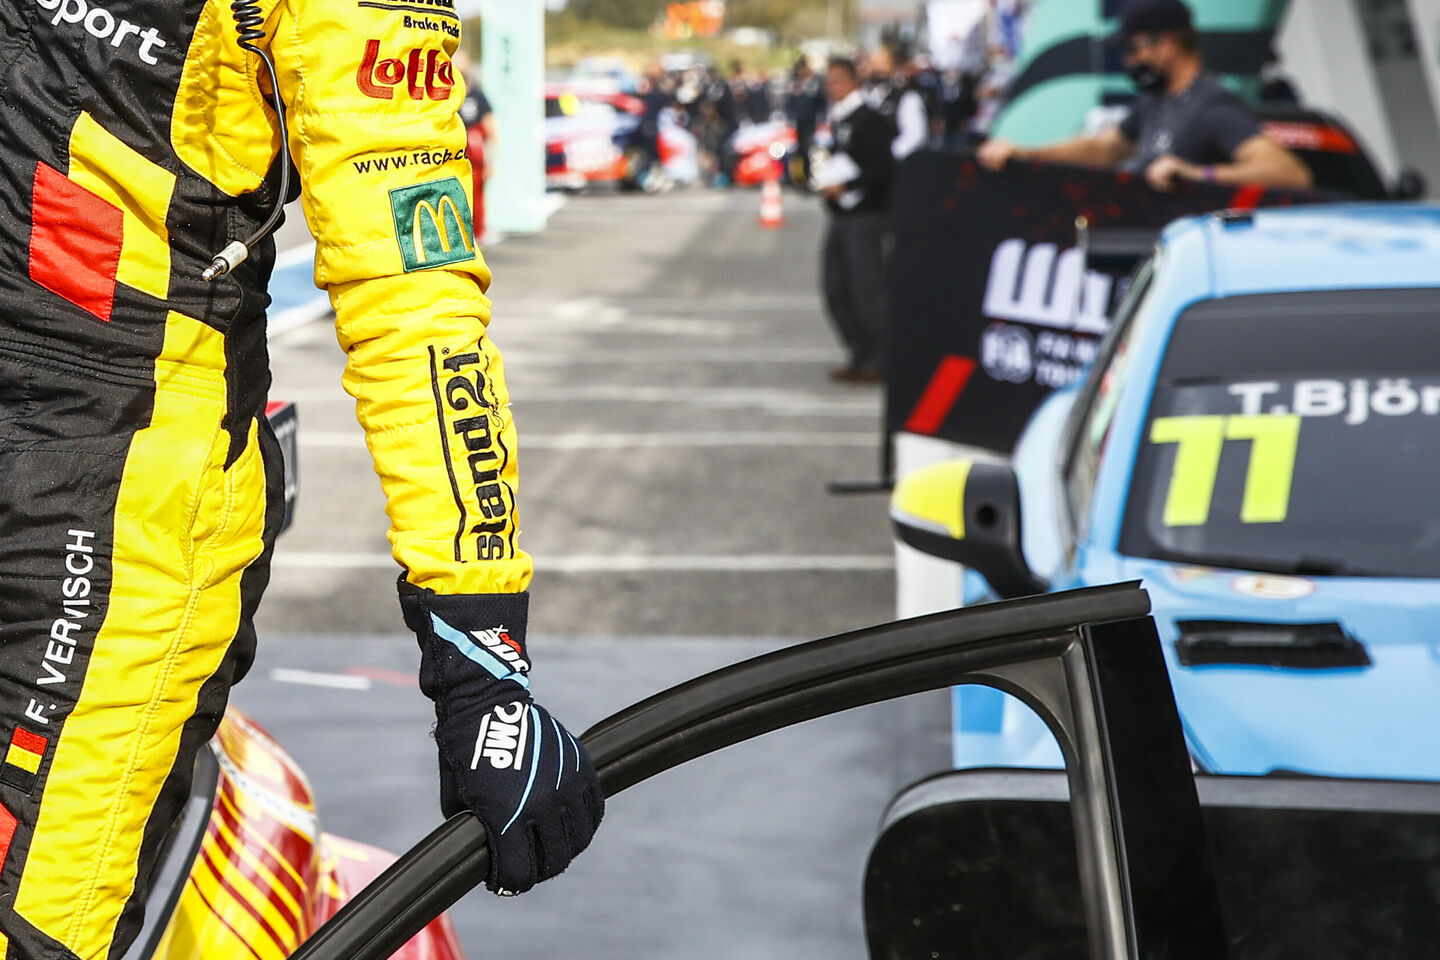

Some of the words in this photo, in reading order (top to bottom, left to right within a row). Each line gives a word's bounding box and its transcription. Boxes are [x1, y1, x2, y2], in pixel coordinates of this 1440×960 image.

[403, 15, 440, 32] Brake
[1150, 413, 1302, 527] 11
[24, 698, 57, 725] F.
[480, 700, 524, 770] OMP
